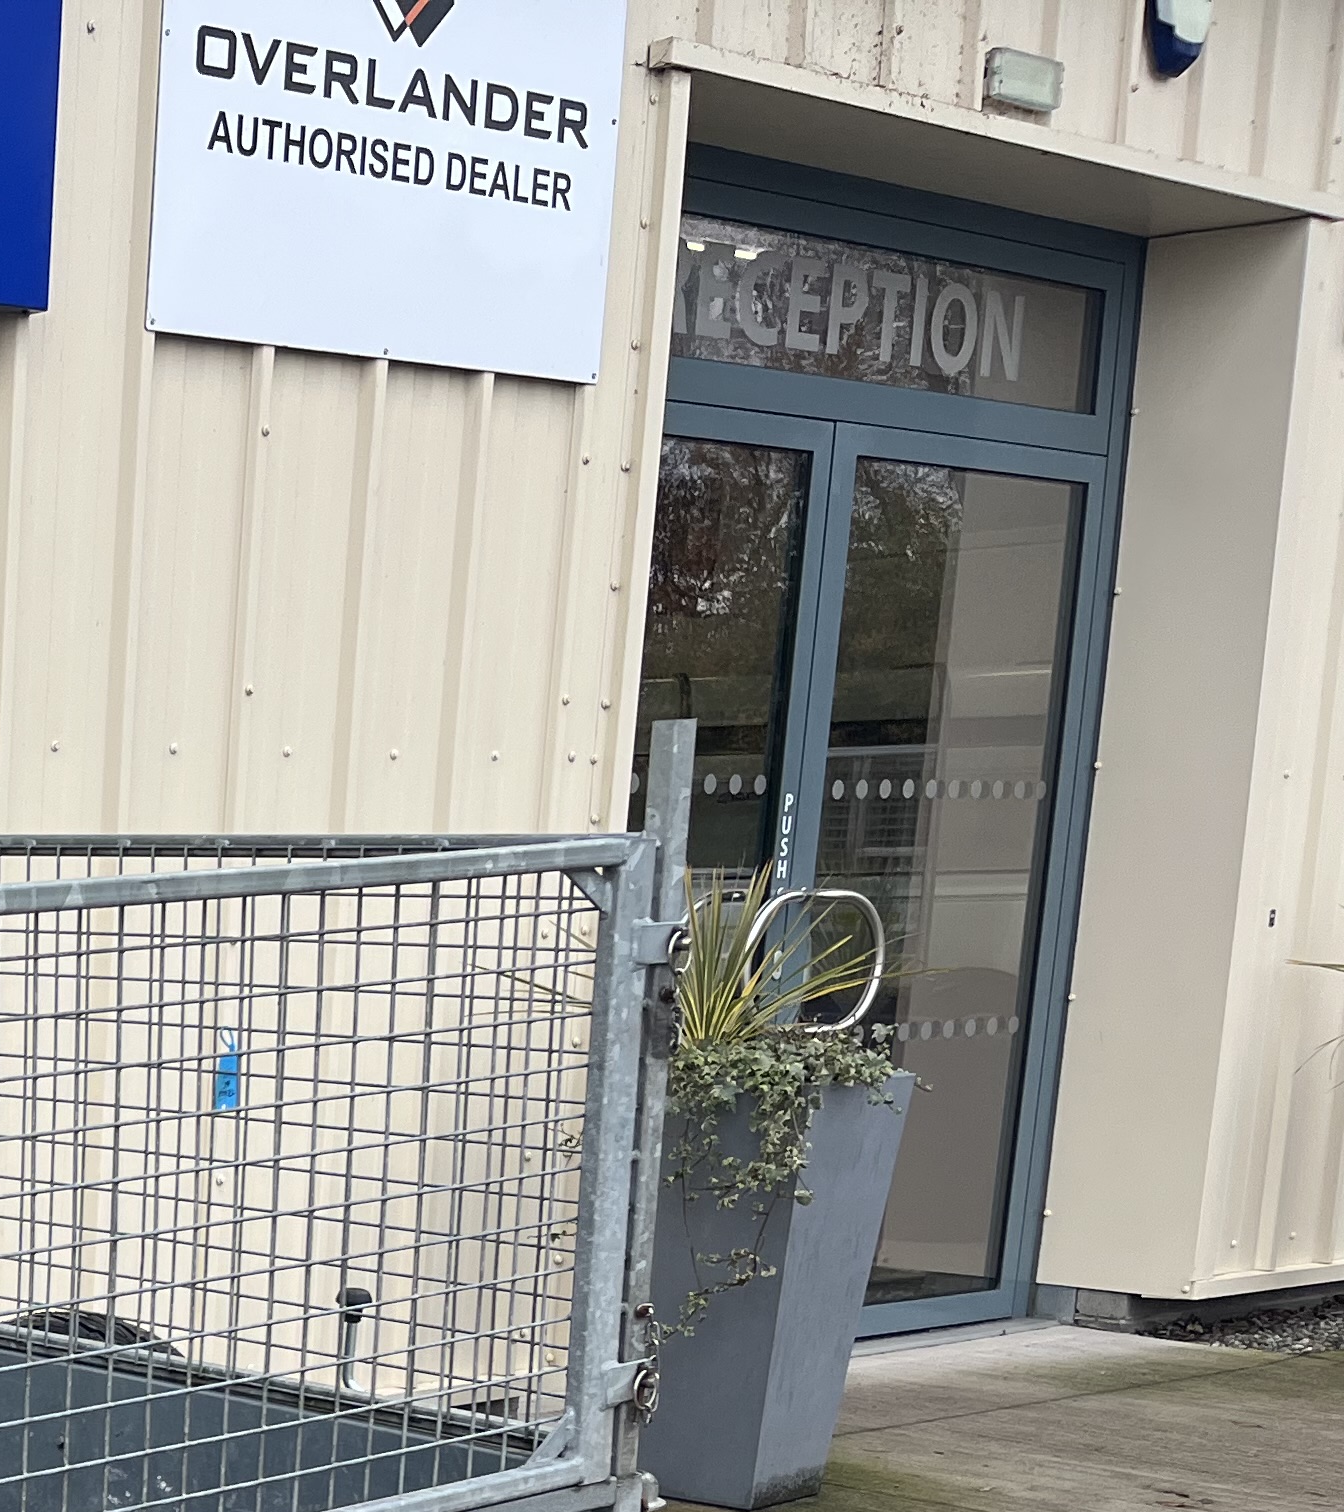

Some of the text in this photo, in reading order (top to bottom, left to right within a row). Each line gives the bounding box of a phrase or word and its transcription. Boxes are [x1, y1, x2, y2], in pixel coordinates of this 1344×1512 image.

[196, 25, 589, 149] OVERLANDER
[207, 110, 572, 212] AUTHORISED DEALER
[776, 793, 794, 879] PUSH
